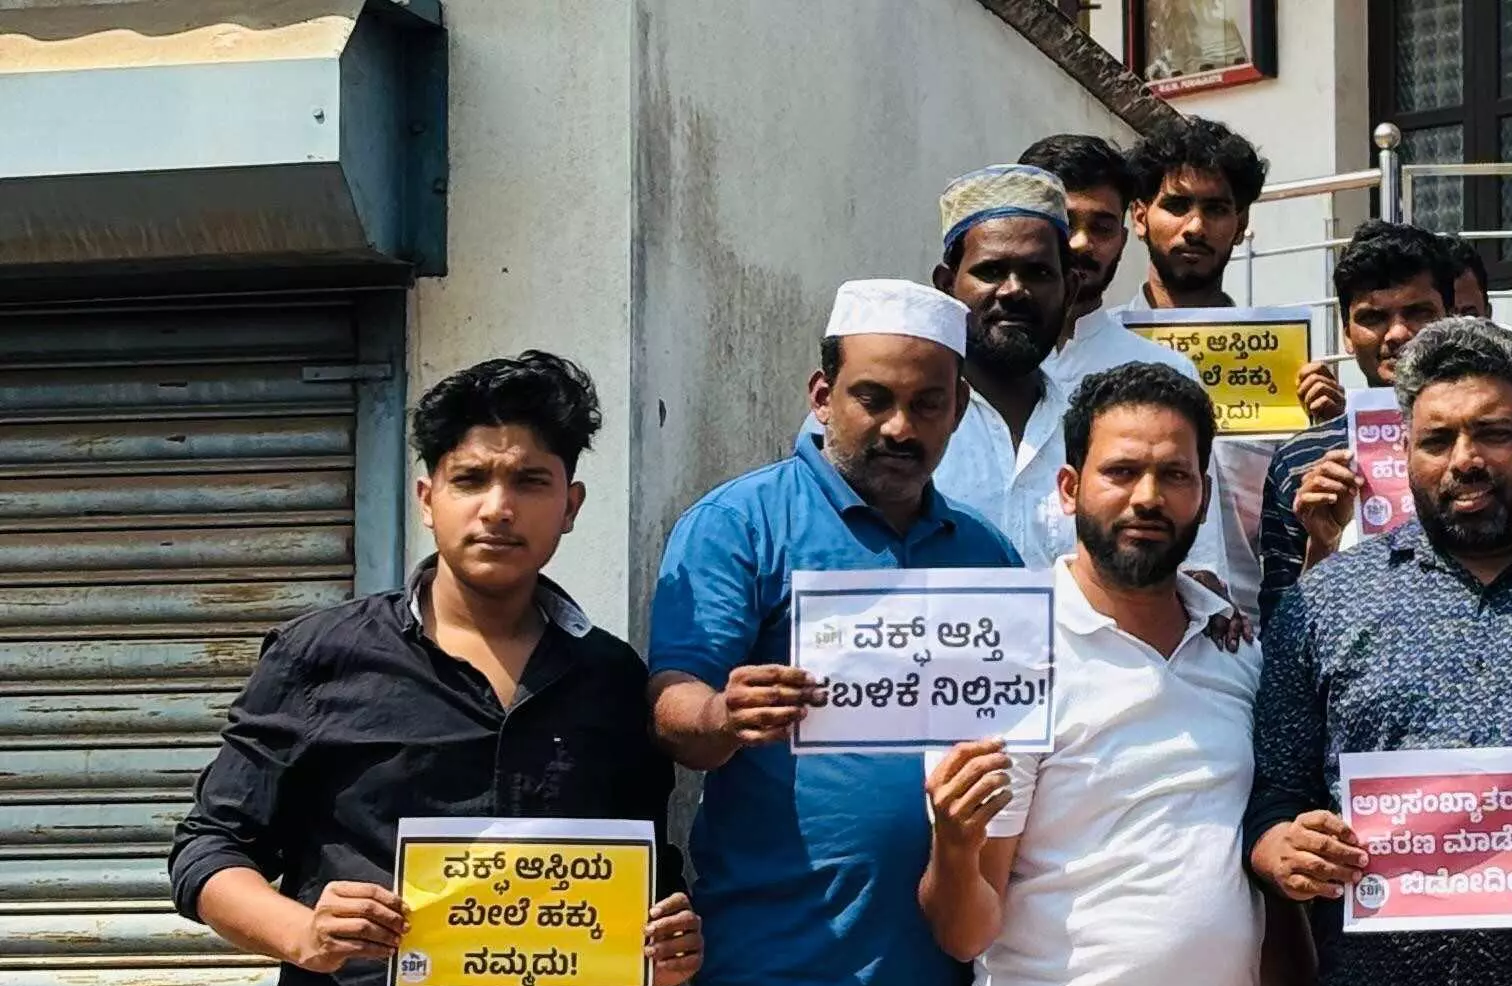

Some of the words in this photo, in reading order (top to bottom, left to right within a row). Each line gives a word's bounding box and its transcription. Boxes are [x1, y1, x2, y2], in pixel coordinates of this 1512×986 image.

[1207, 330, 1279, 360] ಆಸ್ತಿಯ
[853, 616, 932, 667] ವಕ್ಫ್
[937, 616, 1004, 662] ಆಸ್ತಿ
[931, 674, 1046, 719] ನಿಲ್ಲಿಸು!
[1367, 830, 1436, 856] ಹರಣ
[443, 850, 511, 895] ವಕ್ಫ್
[515, 852, 613, 891] ಆಸ್ತಿಯ
[448, 897, 531, 927] ಮೇಲೆ
[536, 899, 604, 940] ಹಕ್ಕು
[400, 957, 427, 973] SDPI
